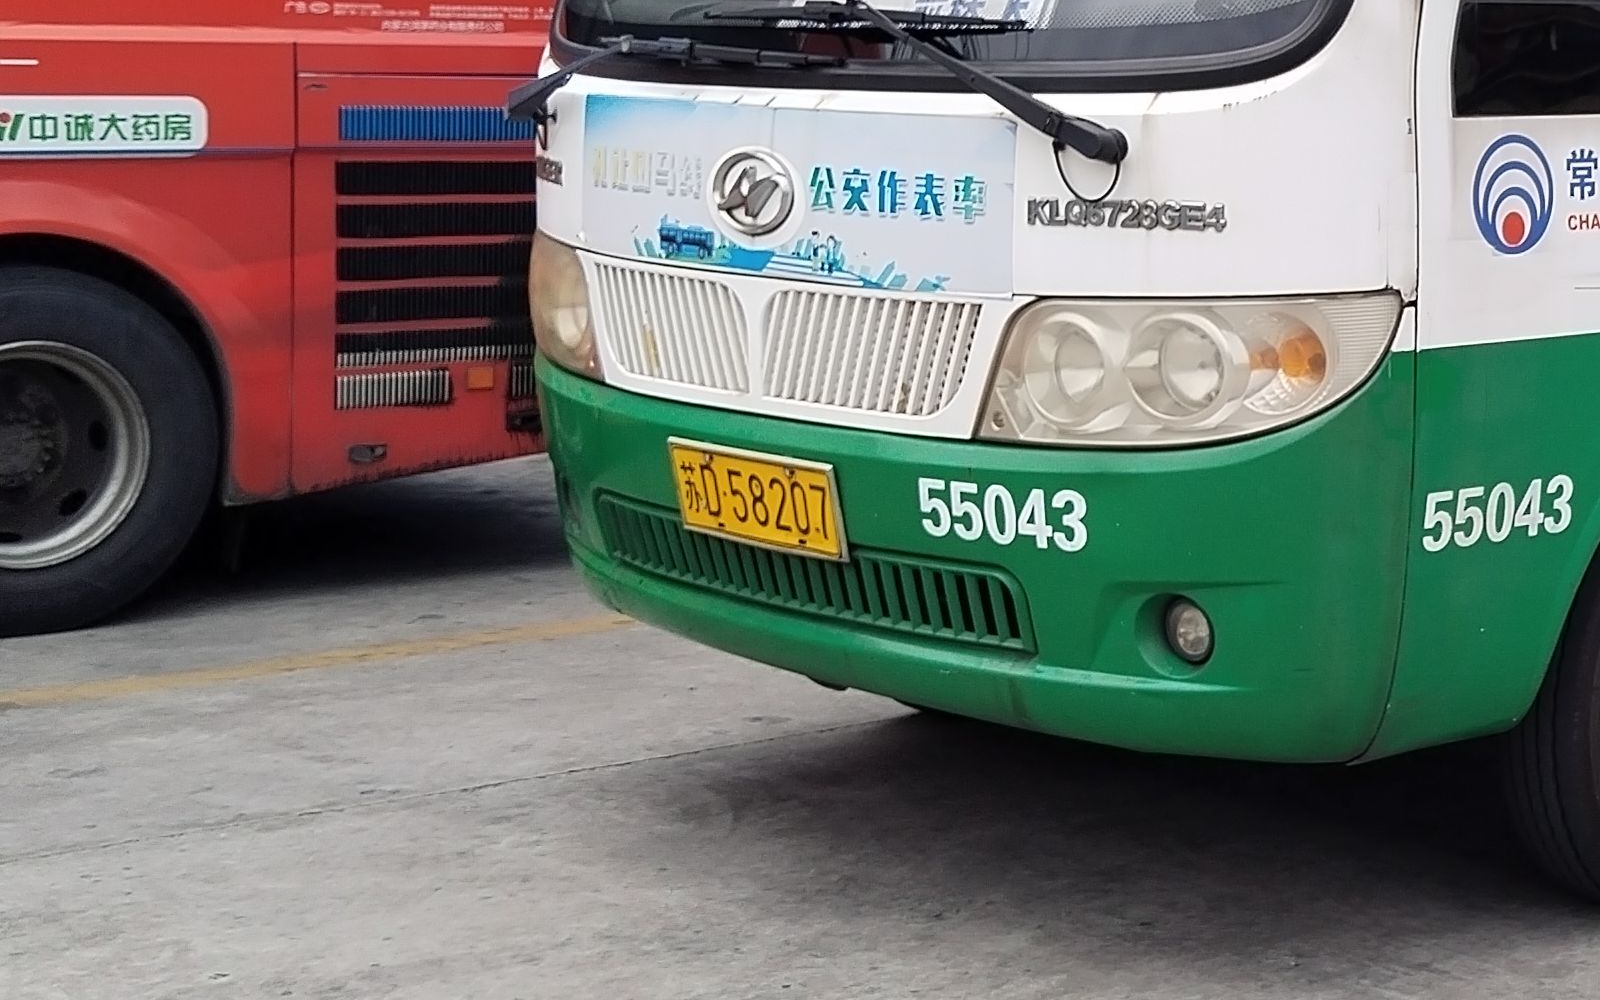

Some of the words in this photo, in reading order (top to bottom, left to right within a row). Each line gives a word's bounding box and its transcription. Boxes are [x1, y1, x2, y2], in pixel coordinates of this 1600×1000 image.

[29, 113, 193, 142] 中诚大药房
[808, 166, 989, 224] 公交作表率
[918, 476, 1088, 553] 55043
[1422, 474, 1574, 552] 55043
